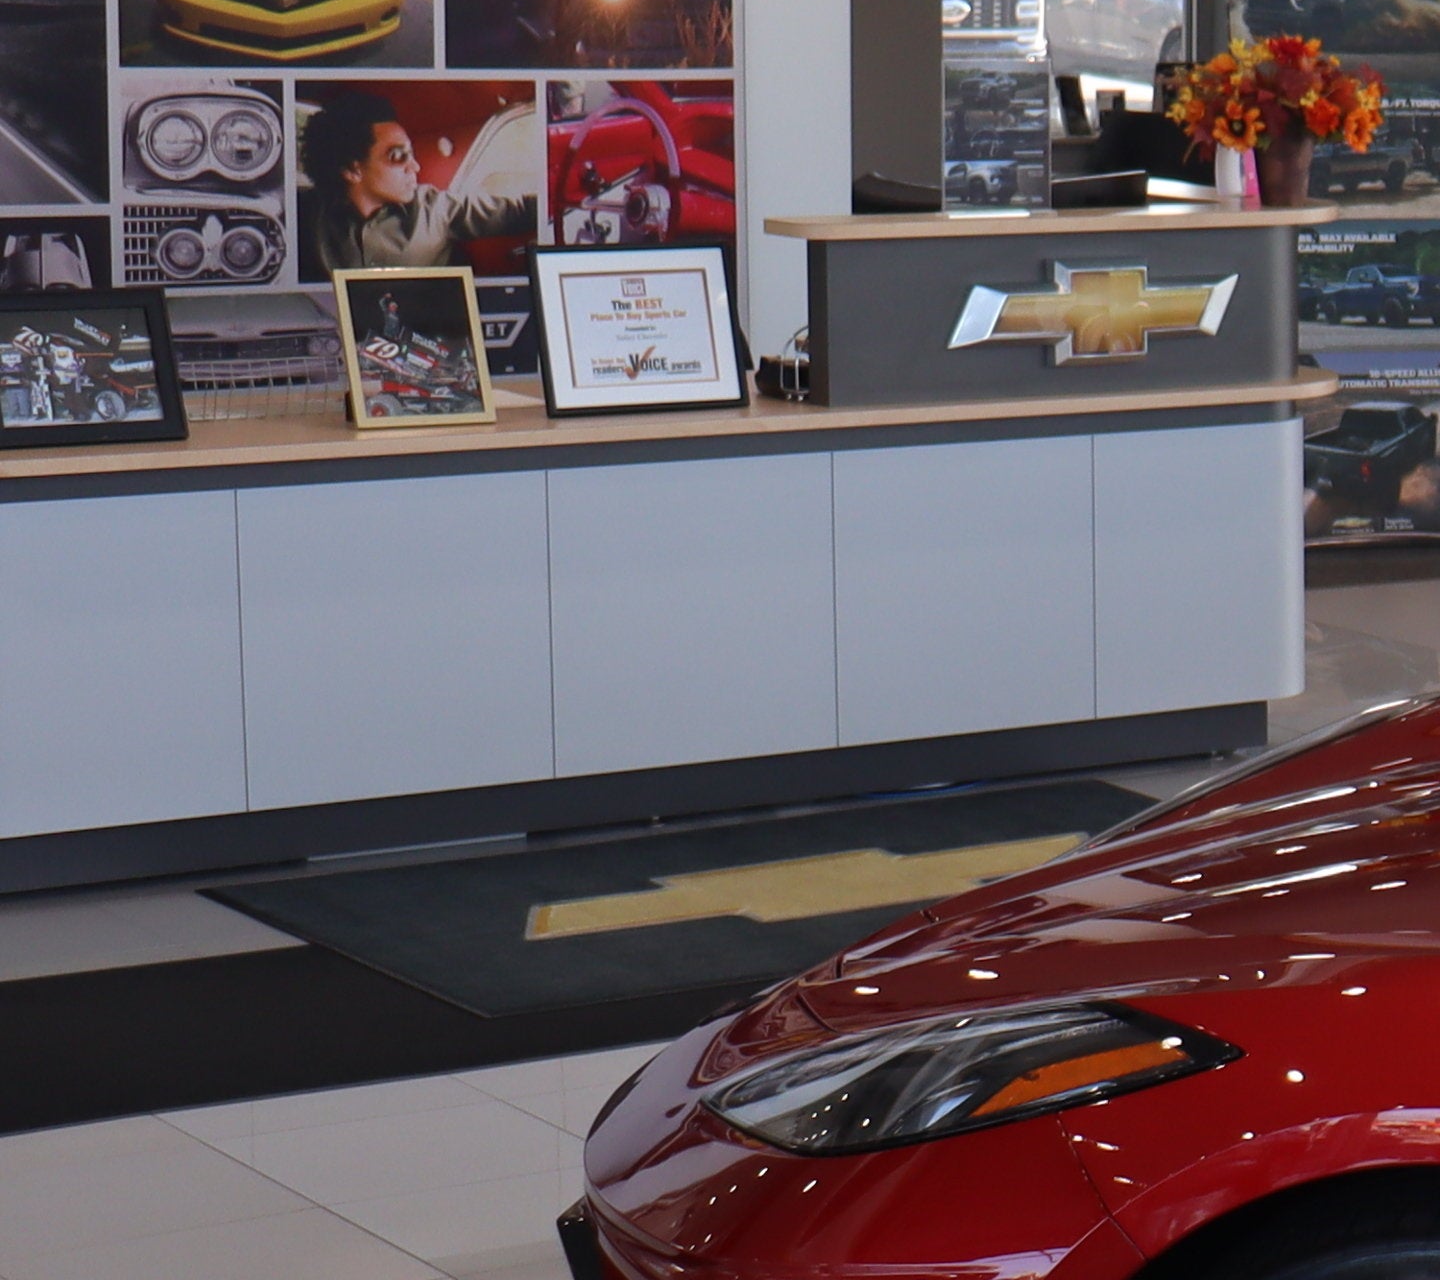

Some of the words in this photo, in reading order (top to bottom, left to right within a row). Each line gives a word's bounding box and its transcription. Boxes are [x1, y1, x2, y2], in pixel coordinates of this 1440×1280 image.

[1319, 233, 1342, 243] MAX
[1344, 233, 1398, 243] AVAILABLE
[1298, 243, 1355, 253] CAPABILITY
[612, 299, 632, 311] The
[635, 298, 663, 309] BEST
[590, 312, 613, 321] Place
[627, 312, 642, 321] Buy
[644, 311, 671, 321] Sports
[366, 336, 399, 359] 79
[629, 353, 669, 372] VOICE
[1339, 379, 1388, 389] UTOMATIC
